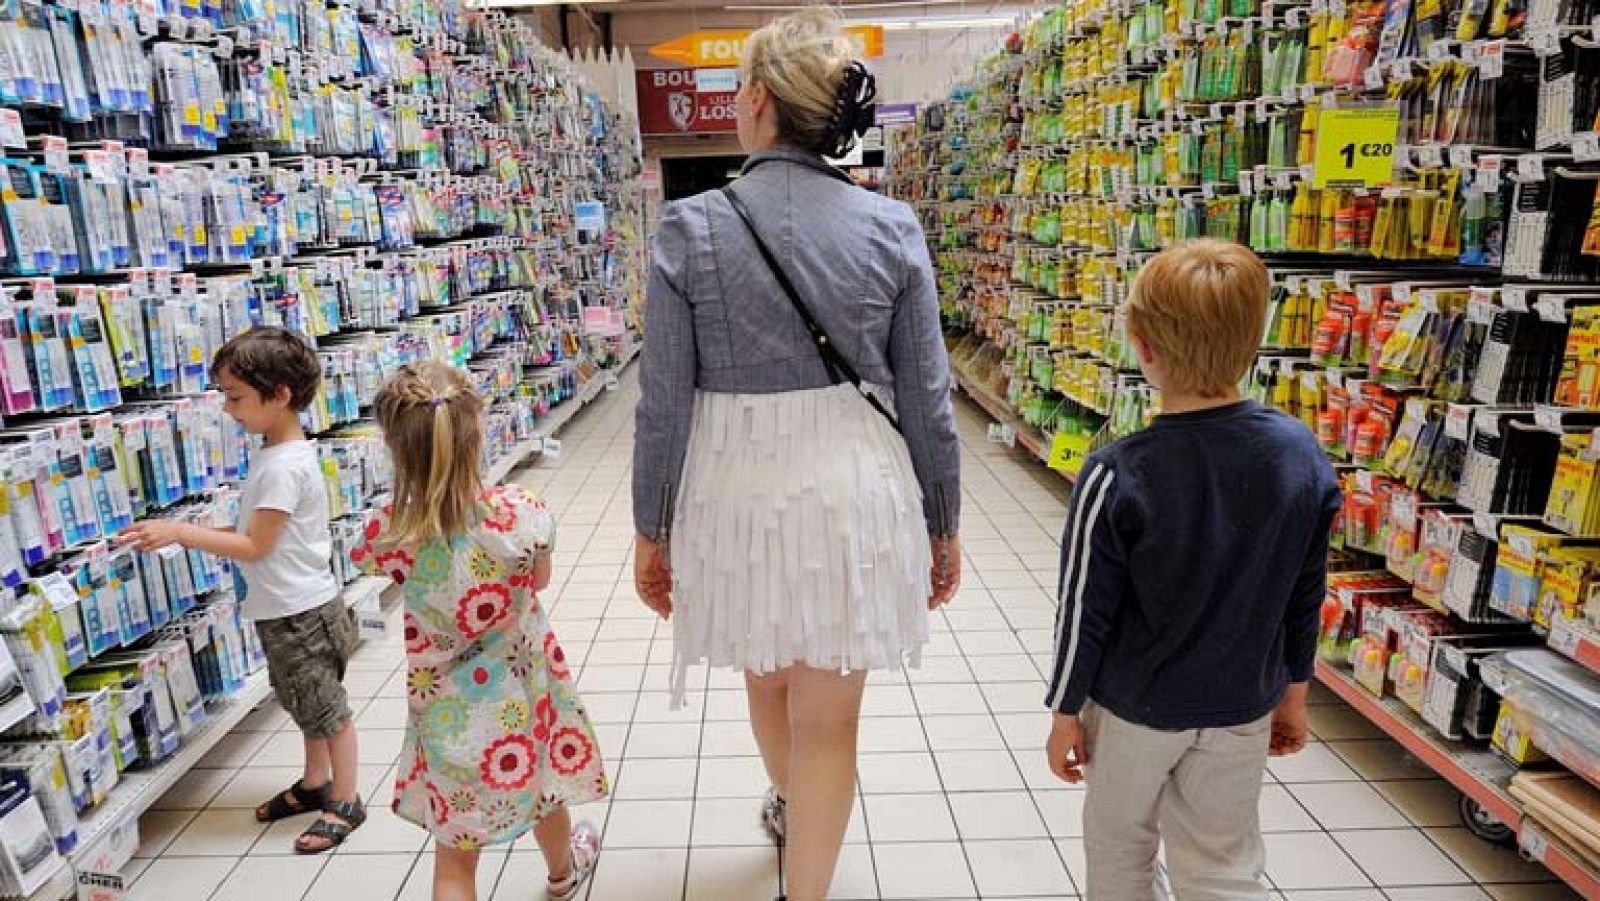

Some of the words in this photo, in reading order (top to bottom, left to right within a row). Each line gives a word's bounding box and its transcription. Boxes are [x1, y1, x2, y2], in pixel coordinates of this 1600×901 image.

[700, 40, 746, 60] FOU
[653, 70, 696, 87] BOU
[1339, 143, 1355, 169] 1
